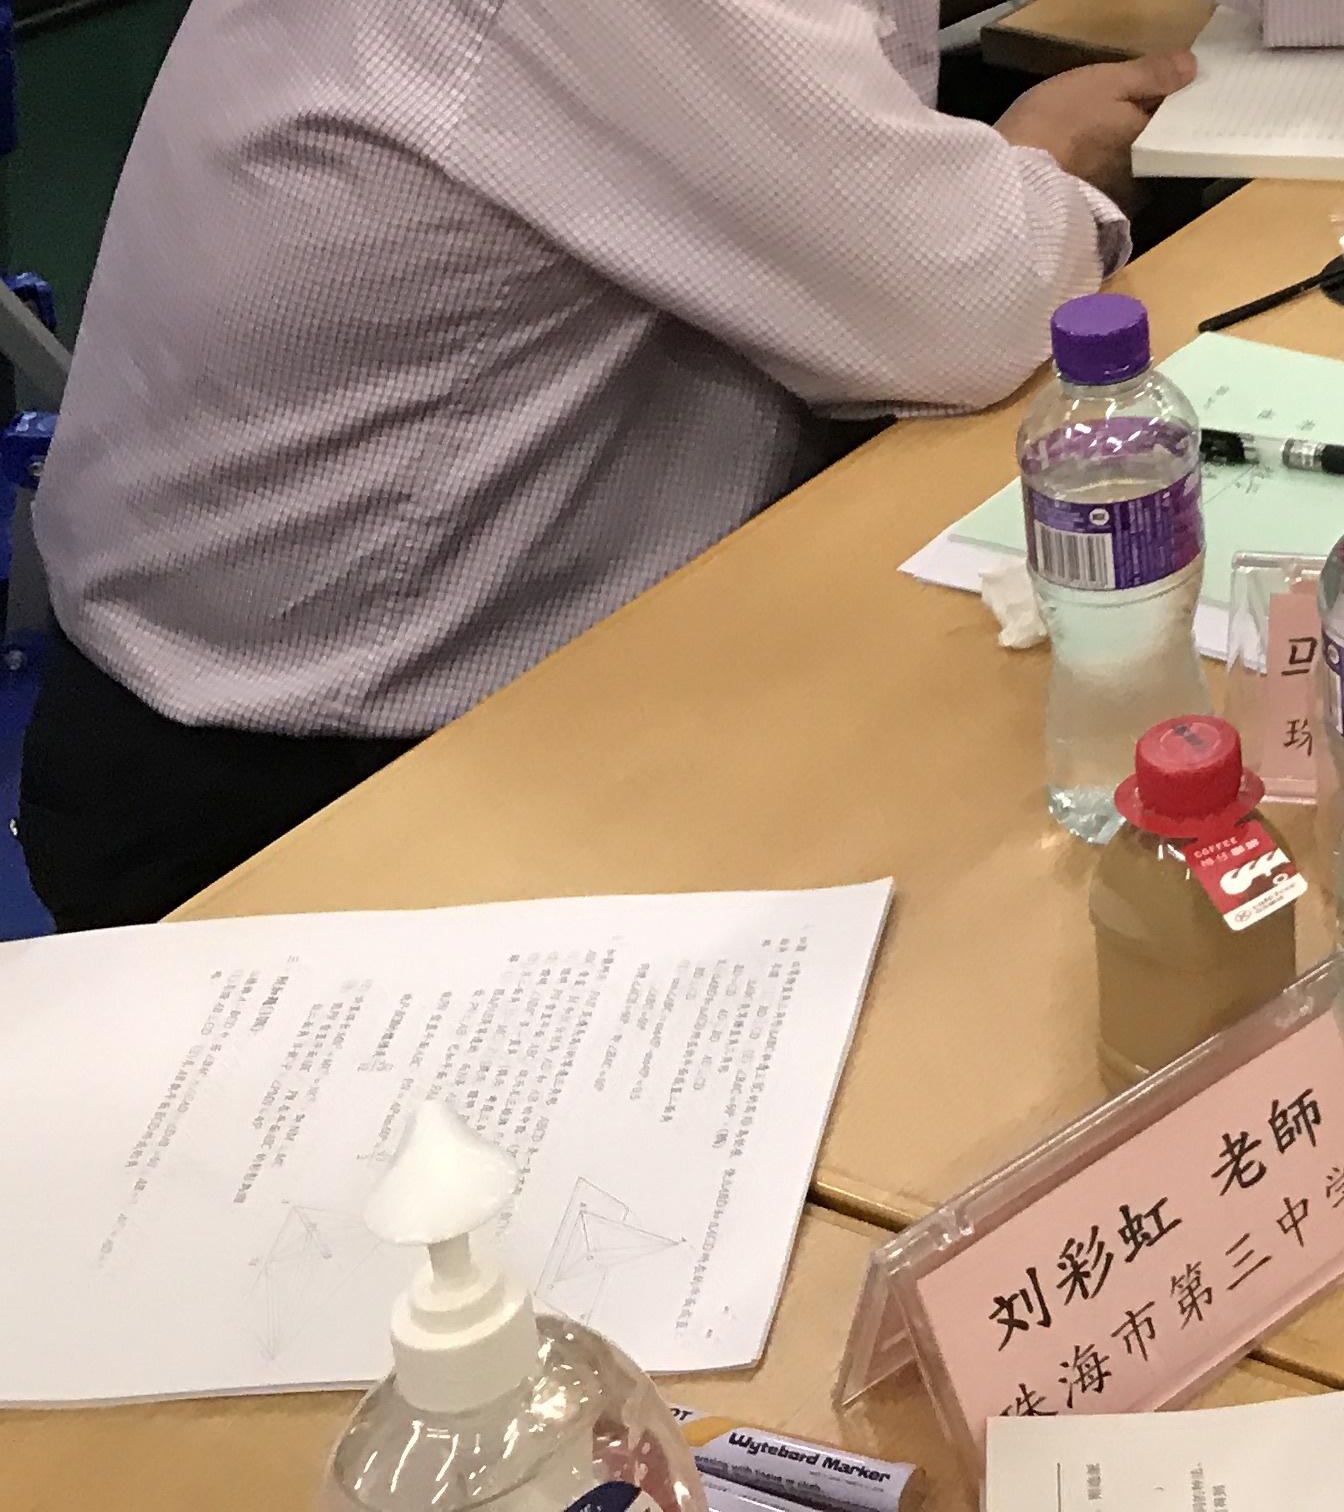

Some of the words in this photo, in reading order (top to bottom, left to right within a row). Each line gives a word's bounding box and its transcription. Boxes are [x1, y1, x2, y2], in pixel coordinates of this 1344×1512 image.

[1192, 832, 1238, 862] COFFEE
[988, 1196, 1183, 1351] 刘彩虹
[1210, 1087, 1324, 1197] 老師
[728, 1430, 818, 1468] Wytebord
[814, 1451, 892, 1486] Marker
